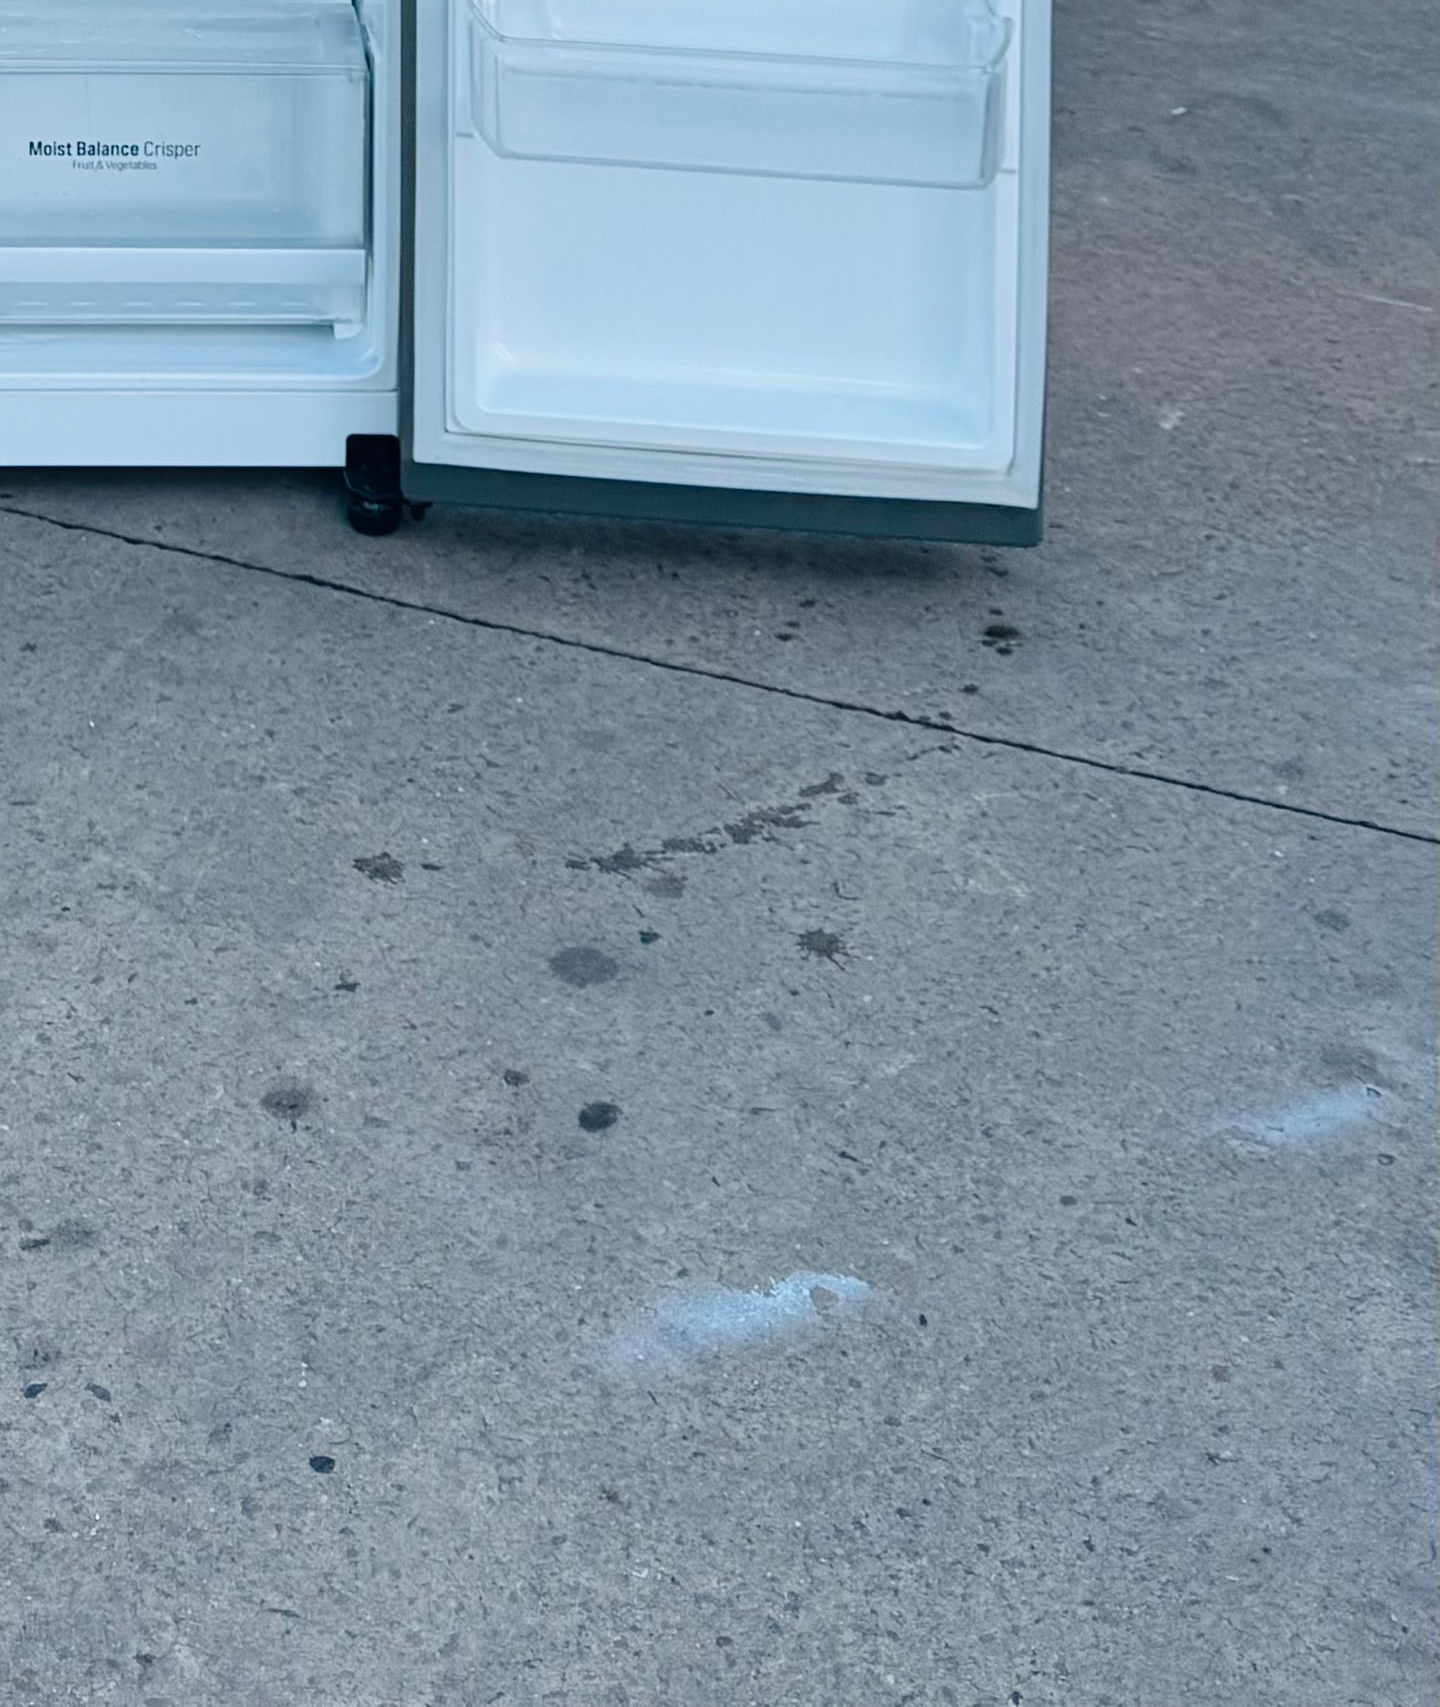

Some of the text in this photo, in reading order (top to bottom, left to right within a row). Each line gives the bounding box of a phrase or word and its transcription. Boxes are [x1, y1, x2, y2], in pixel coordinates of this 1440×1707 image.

[28, 140, 201, 159] Moist Balance Crisper
[72, 160, 158, 172] Fruit & Vegetables
